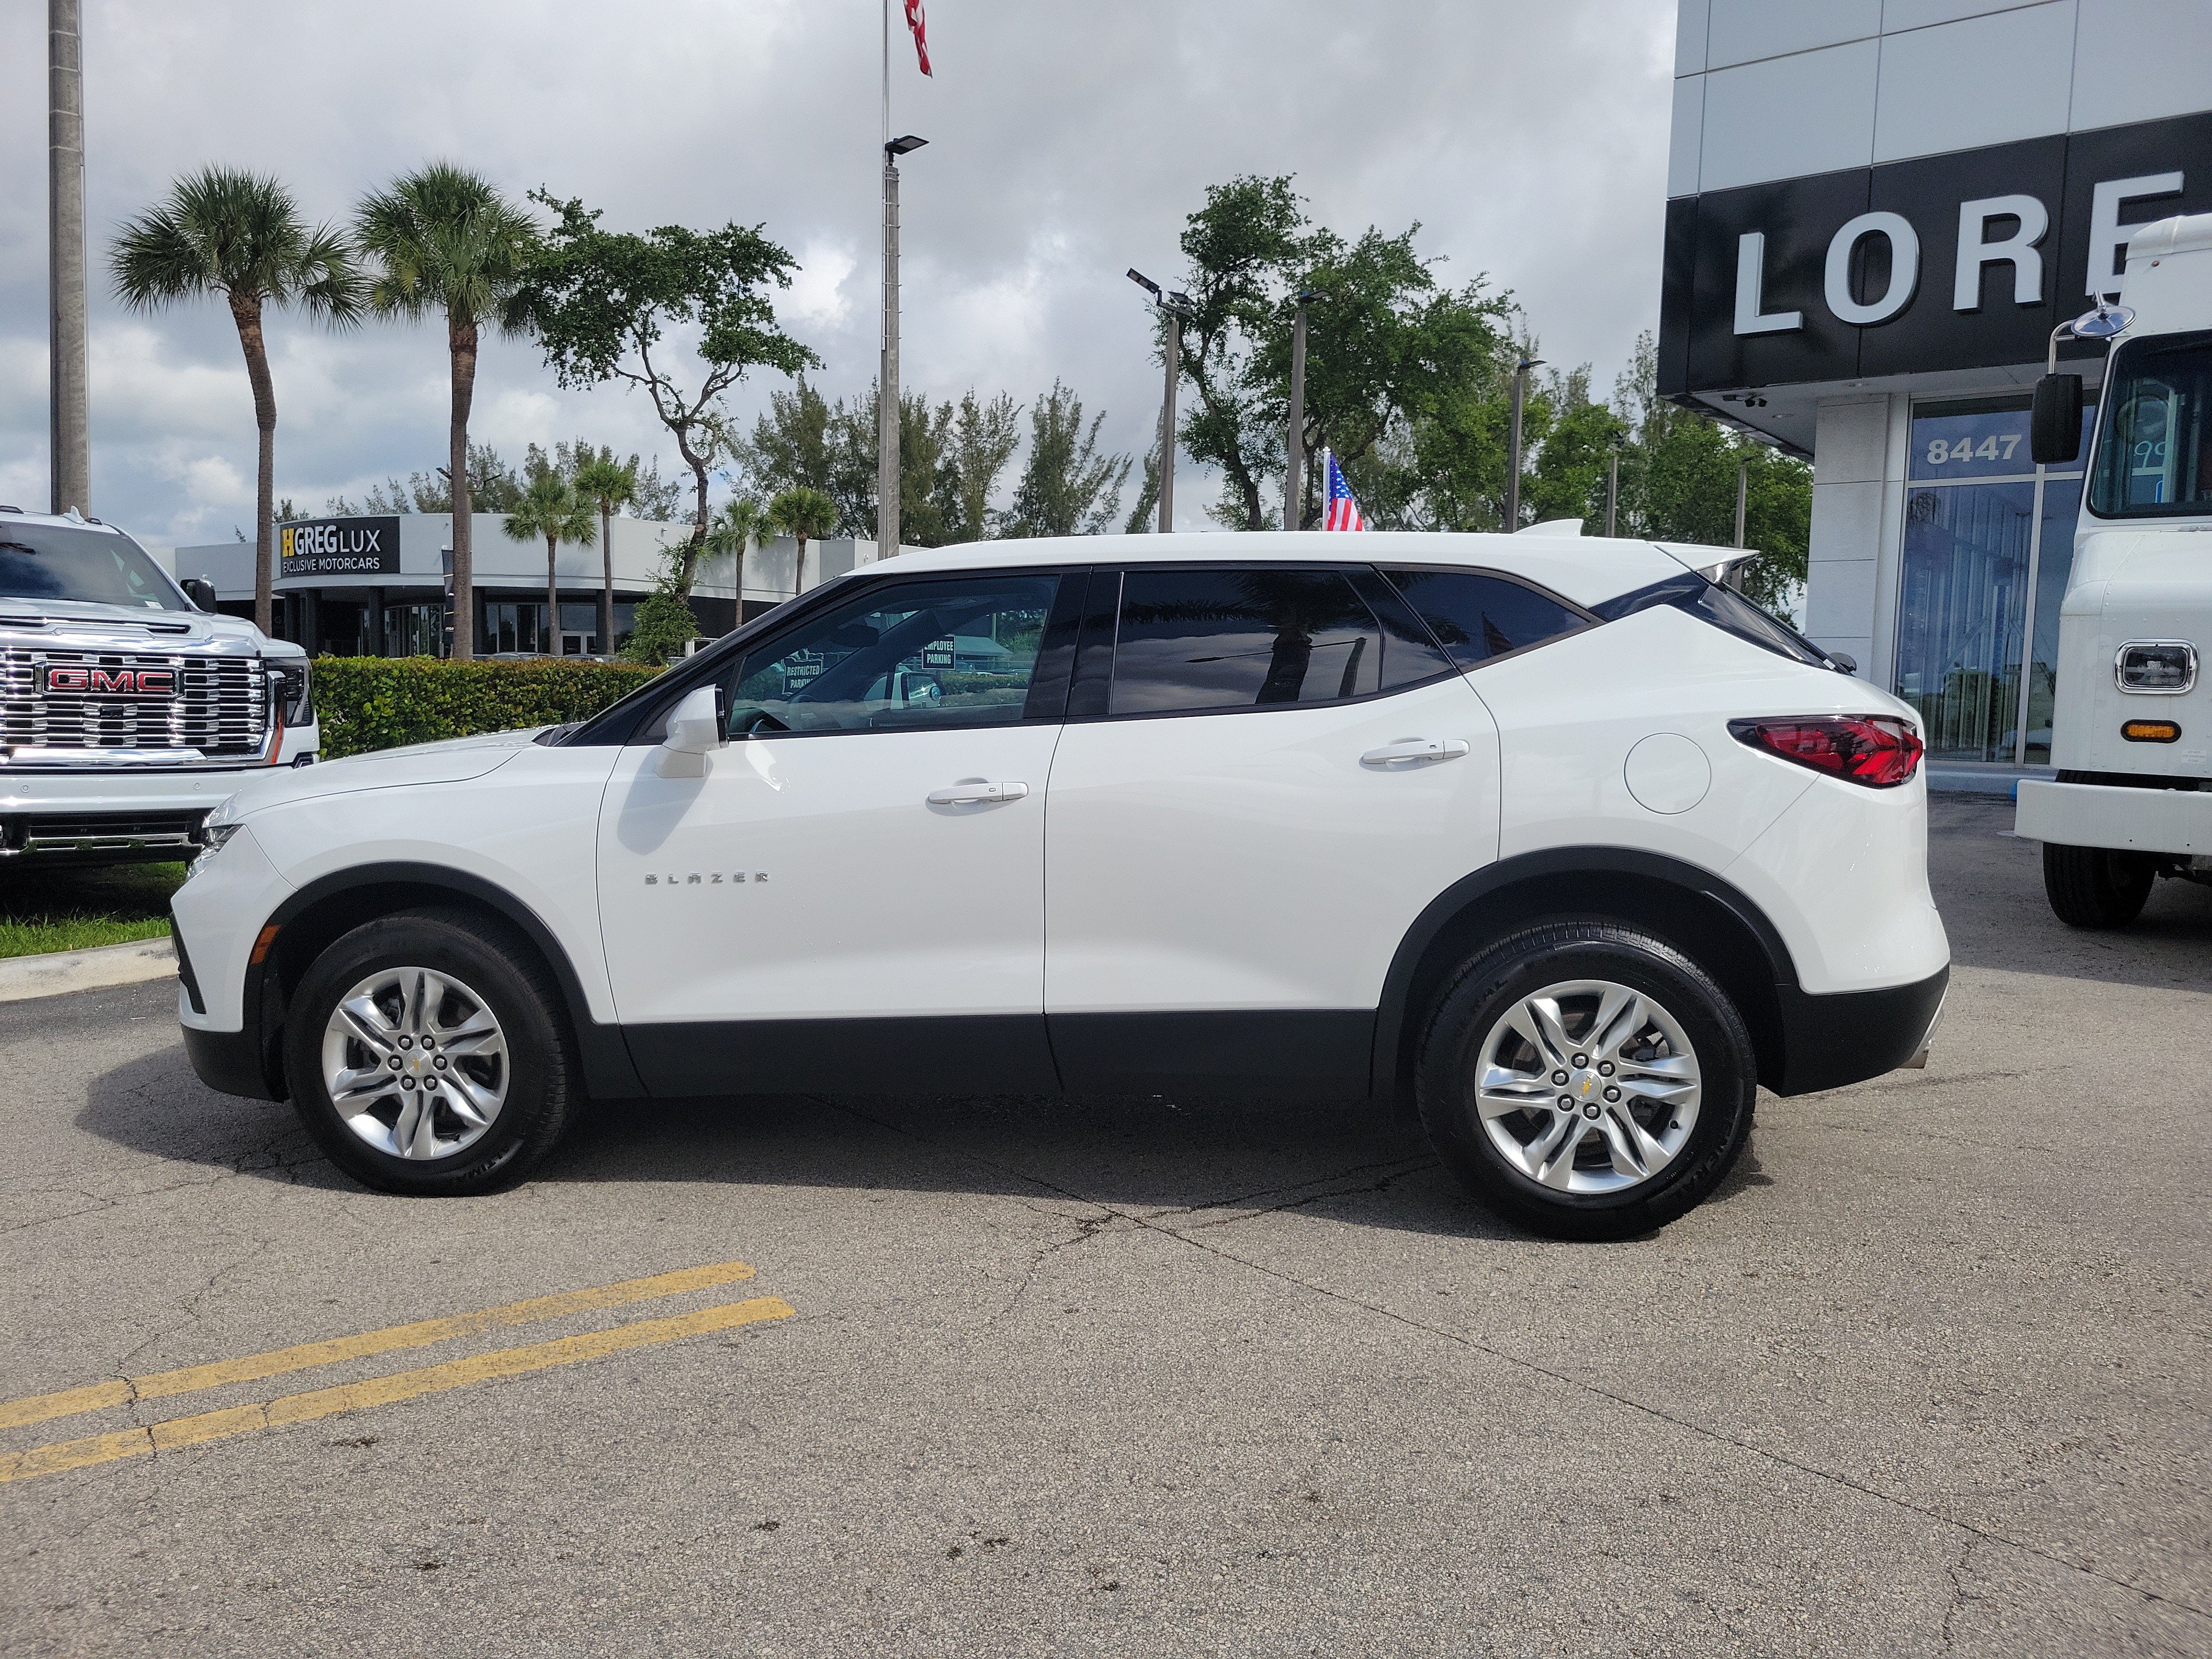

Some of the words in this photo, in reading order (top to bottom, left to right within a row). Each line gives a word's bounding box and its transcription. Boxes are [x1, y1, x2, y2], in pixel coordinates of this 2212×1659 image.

[1927, 434, 2022, 465] 8447
[283, 558, 317, 573] EXCLUSIVE
[319, 557, 380, 571] MOTORCARS
[927, 653, 951, 664] PARKING
[787, 665, 820, 676] RESTRICTED
[49, 668, 174, 692] GMC
[645, 871, 768, 885] BLAZER
